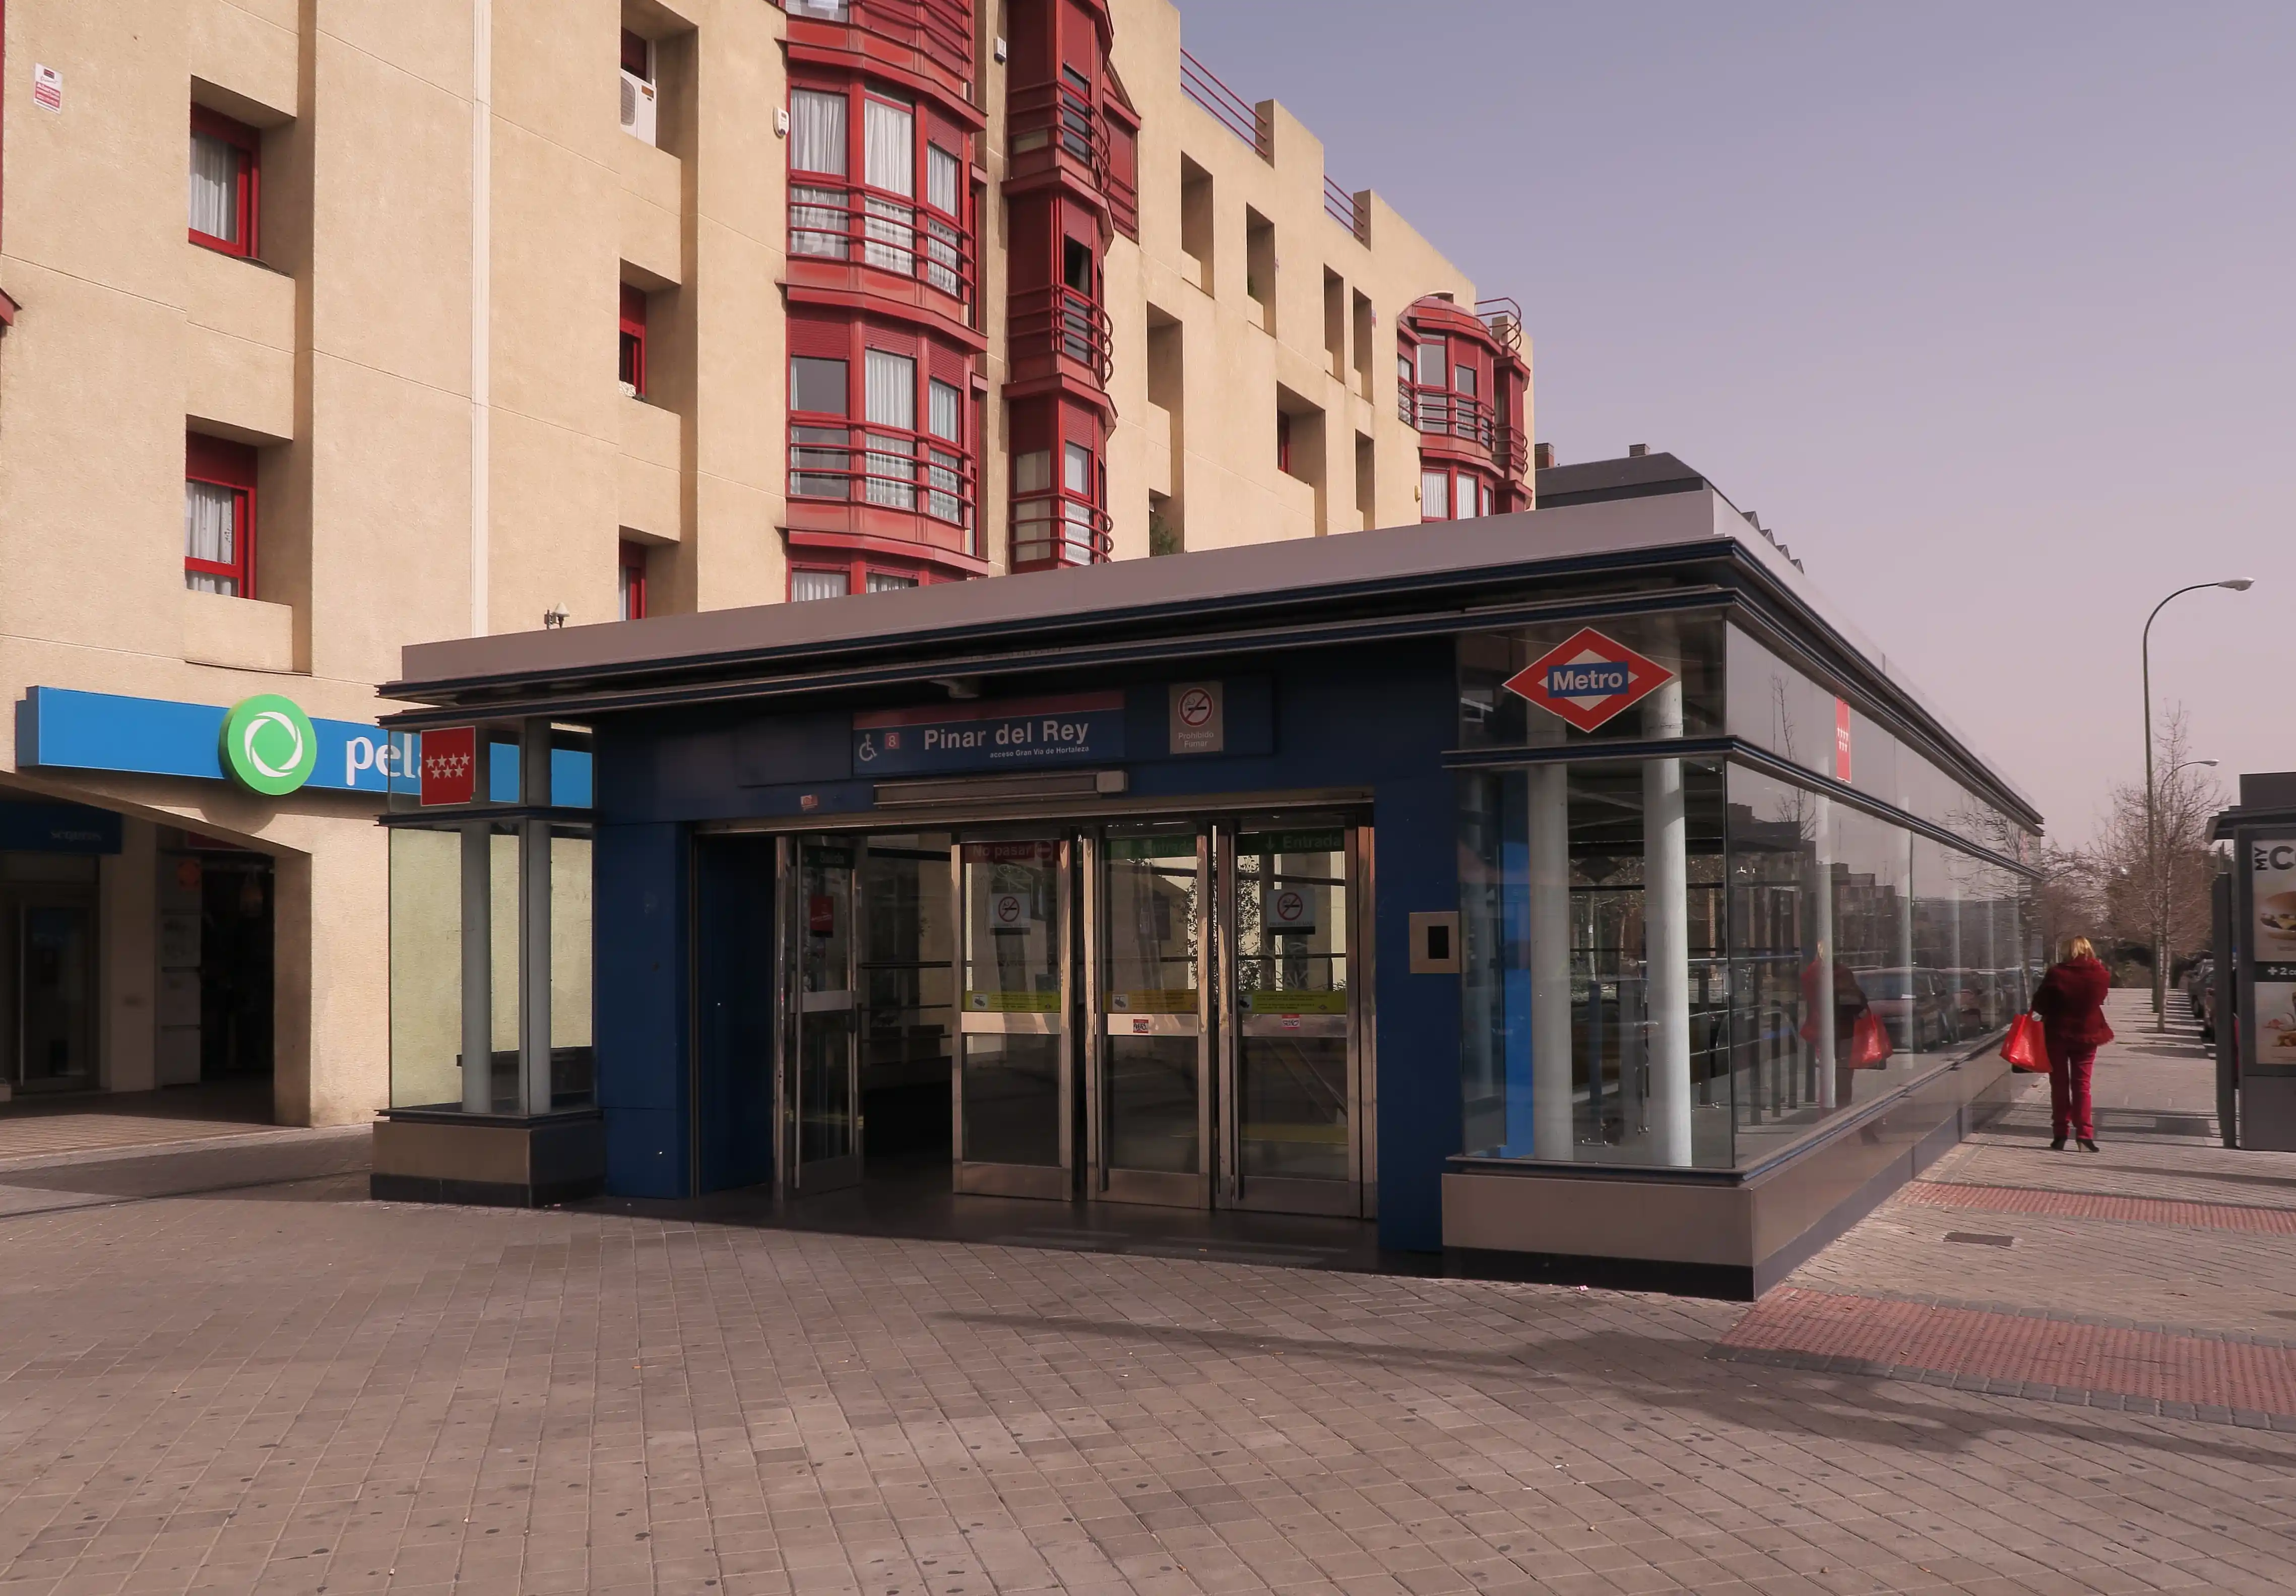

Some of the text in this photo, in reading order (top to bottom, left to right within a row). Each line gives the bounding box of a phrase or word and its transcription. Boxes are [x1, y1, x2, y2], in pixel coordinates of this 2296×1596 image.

[1553, 670, 1623, 691] Metro
[887, 735, 897, 747] 8
[924, 720, 1089, 750] Pinar del Rey
[1178, 731, 1214, 740] Prohibido
[989, 750, 1014, 758] acceso
[1015, 748, 1032, 757] Gran
[1056, 745, 1090, 755] Hortaleza
[1184, 740, 1208, 748] Fumar
[346, 733, 422, 786] pel
[1283, 834, 1342, 849] Entrada
[973, 845, 1032, 860] No pasar
[2254, 847, 2268, 871] MY
[2269, 845, 2296, 871] C
[2279, 967, 2288, 976] 2
